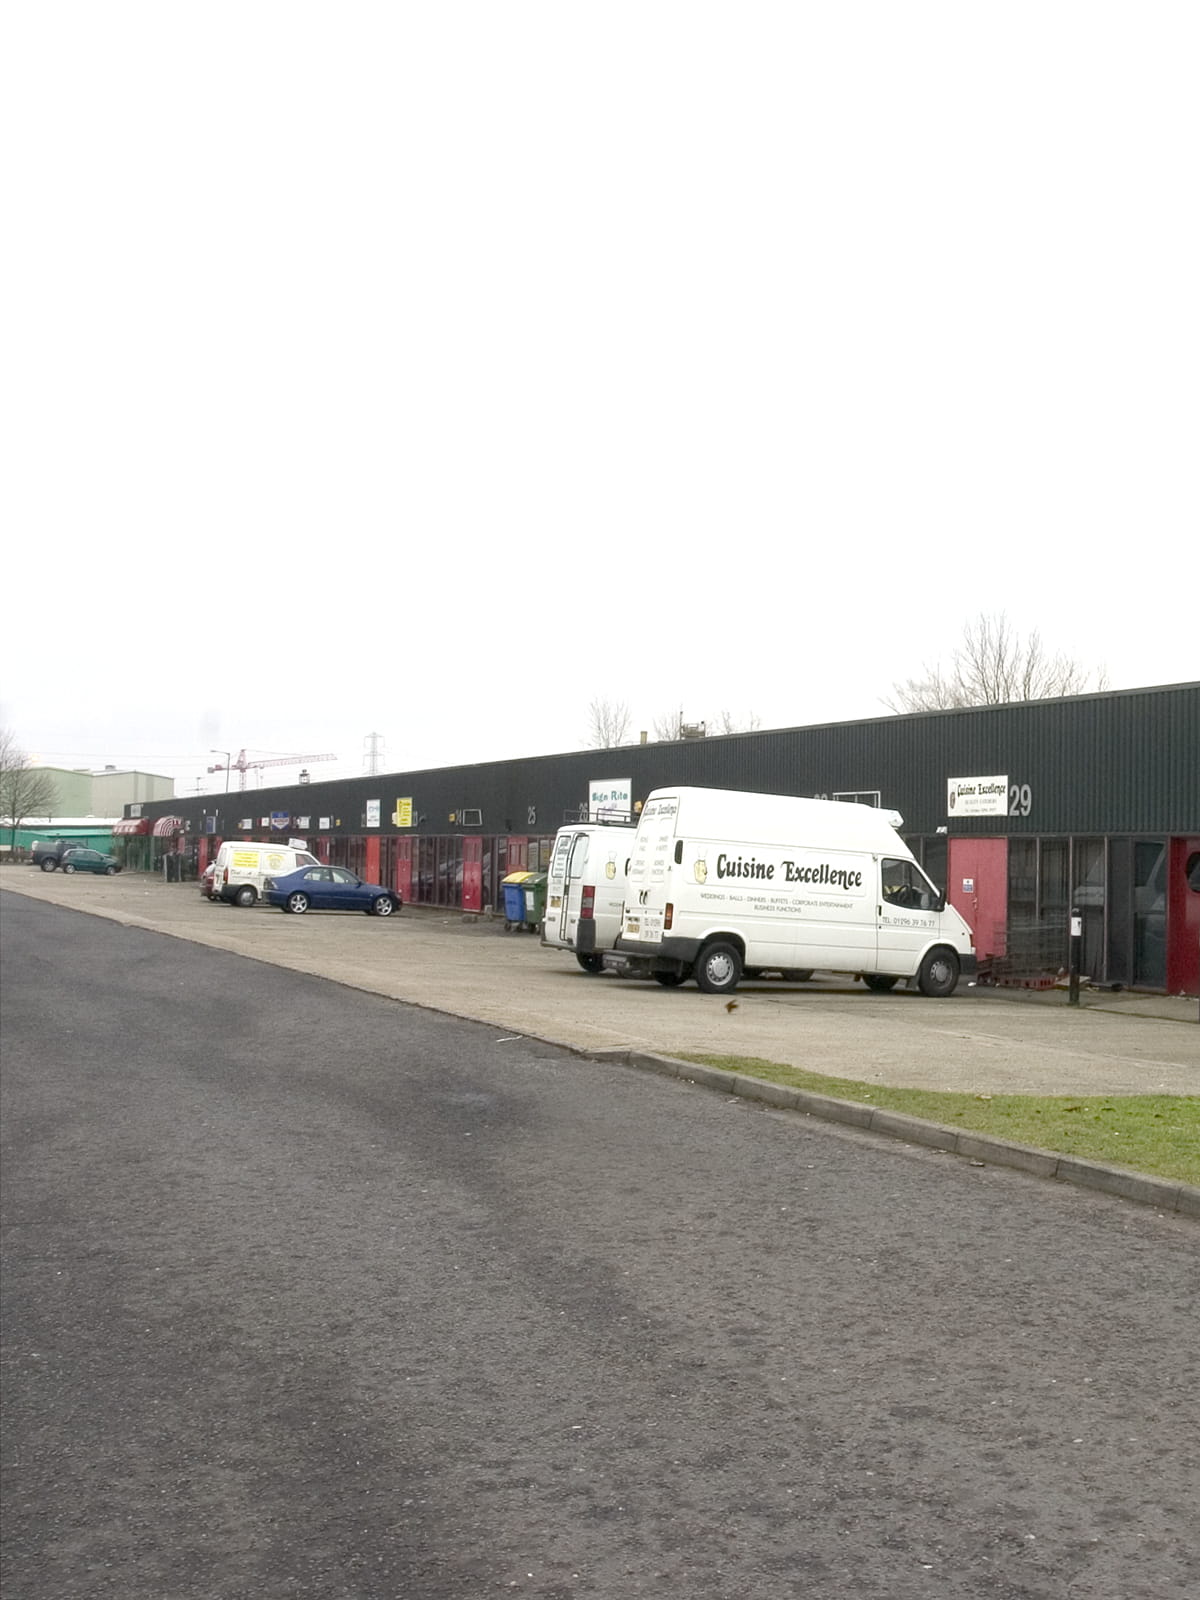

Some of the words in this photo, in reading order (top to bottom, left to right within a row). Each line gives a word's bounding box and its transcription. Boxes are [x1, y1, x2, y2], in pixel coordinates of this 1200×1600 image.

[528, 806, 536, 825] 25
[1009, 784, 1032, 817] 29
[717, 854, 775, 879] Cuisine
[780, 860, 862, 890] Excellence
